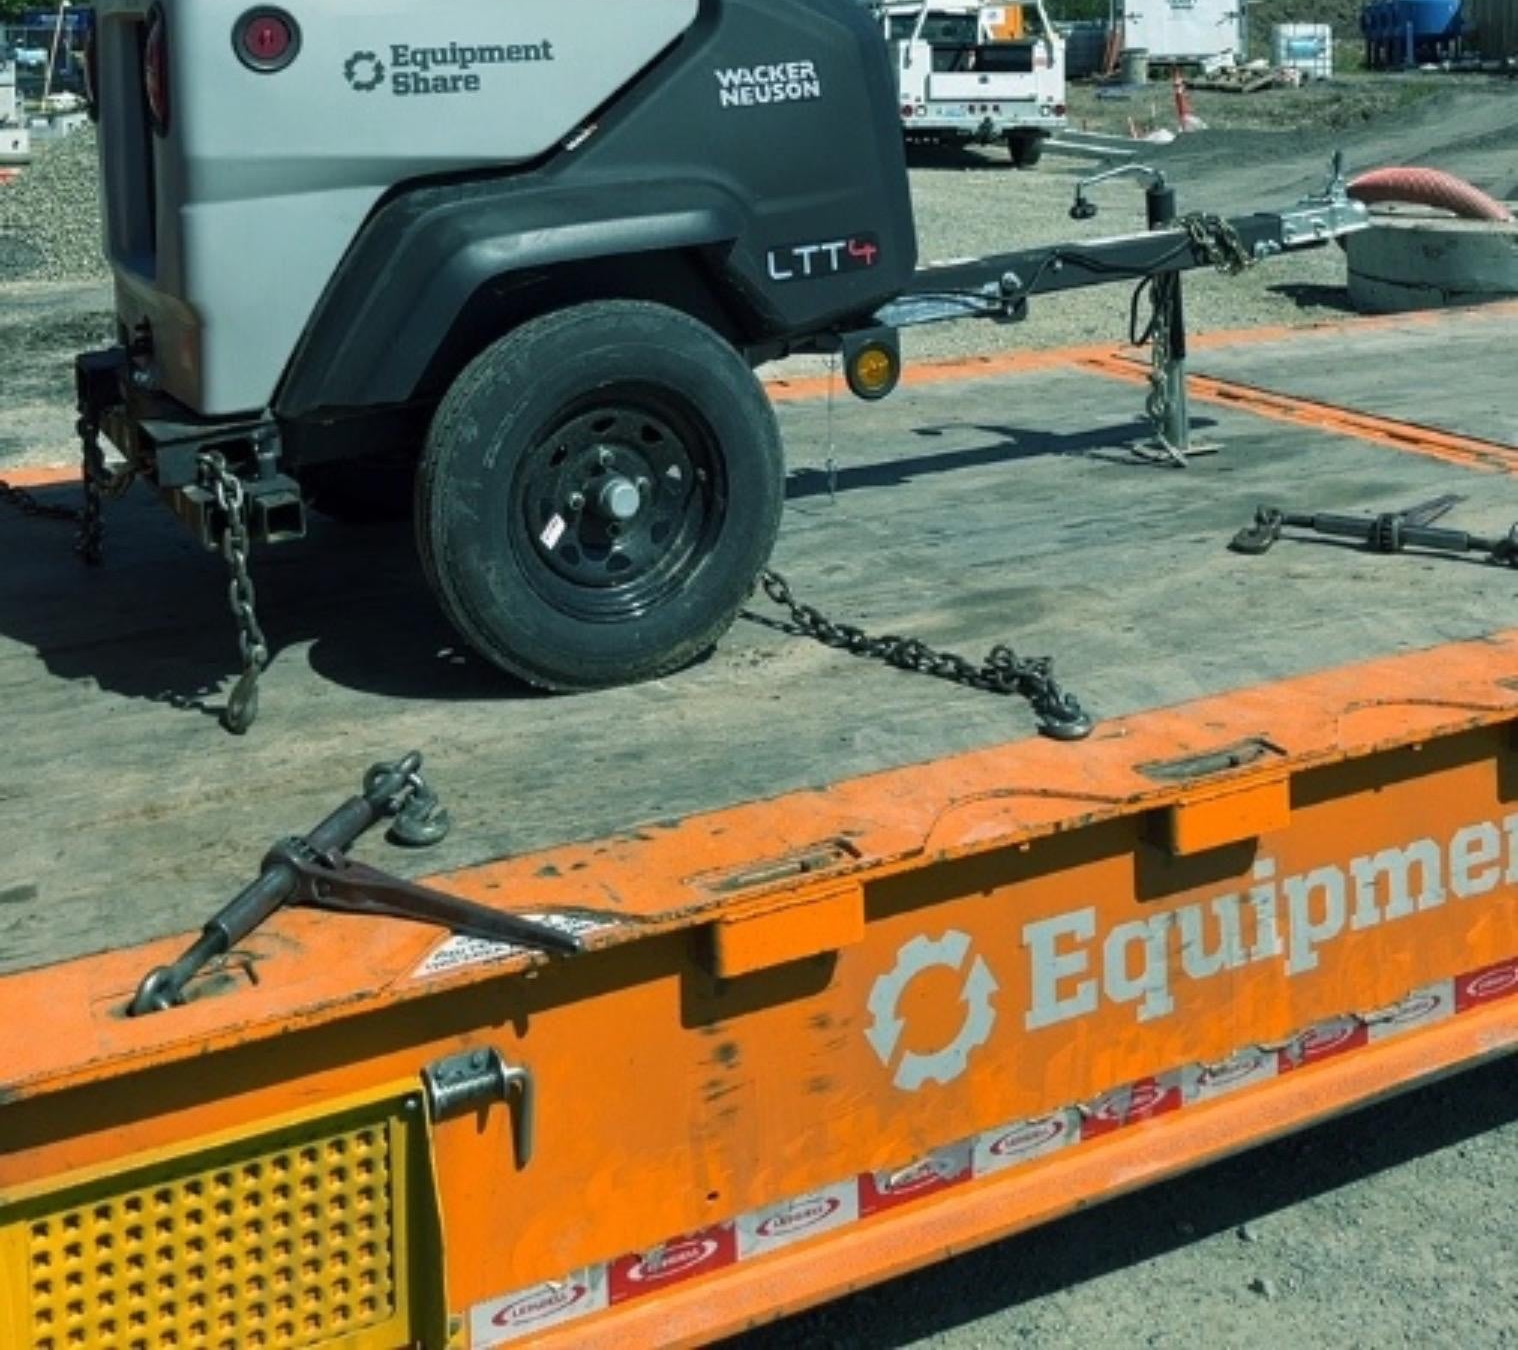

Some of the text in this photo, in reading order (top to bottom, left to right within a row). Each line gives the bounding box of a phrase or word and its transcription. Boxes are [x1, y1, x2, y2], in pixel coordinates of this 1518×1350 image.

[389, 39, 555, 71] Equipment
[391, 71, 481, 96] Share
[714, 59, 818, 88] WACKER
[719, 80, 821, 108] NEUSON
[767, 239, 877, 280] LTT4
[1021, 810, 1518, 1032] Equipme
